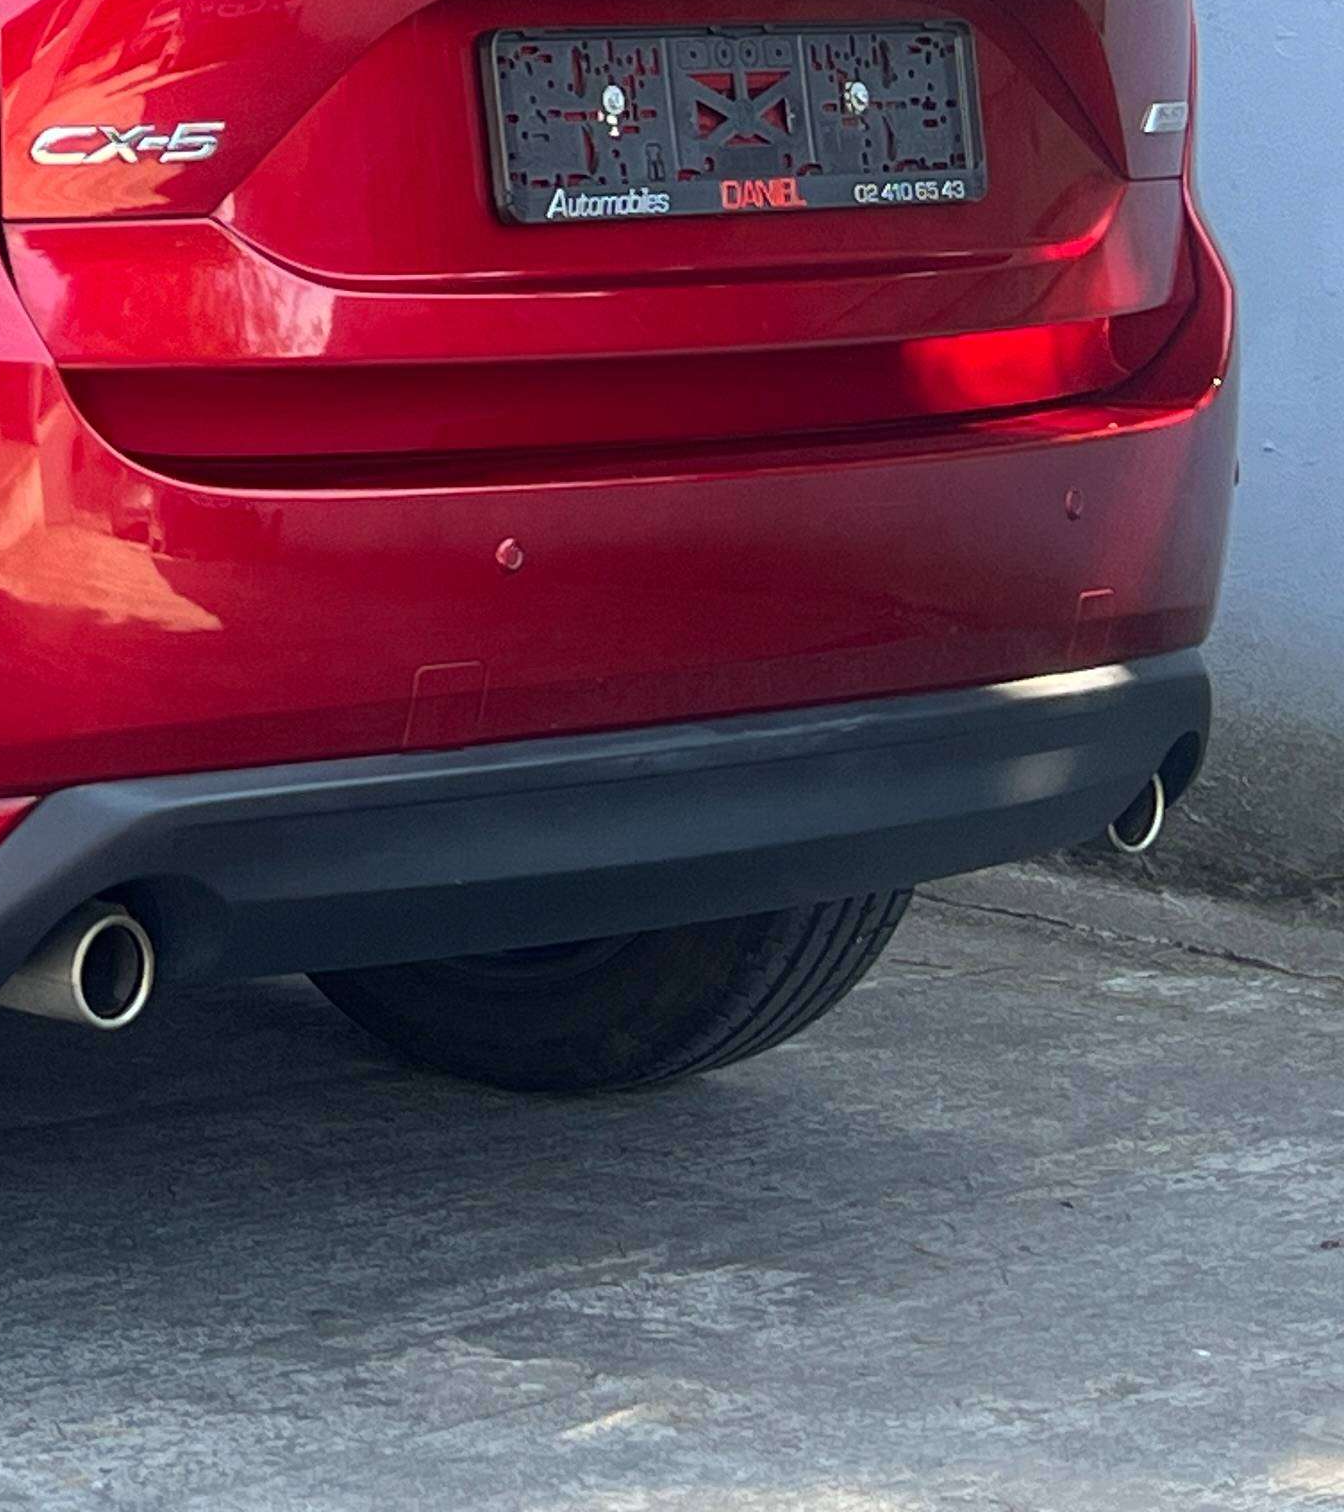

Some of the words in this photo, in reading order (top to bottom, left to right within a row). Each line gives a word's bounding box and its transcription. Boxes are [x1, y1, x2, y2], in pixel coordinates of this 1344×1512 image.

[30, 121, 226, 165] CX-5
[546, 187, 670, 219] Automobiles
[720, 177, 808, 209] DANIEL
